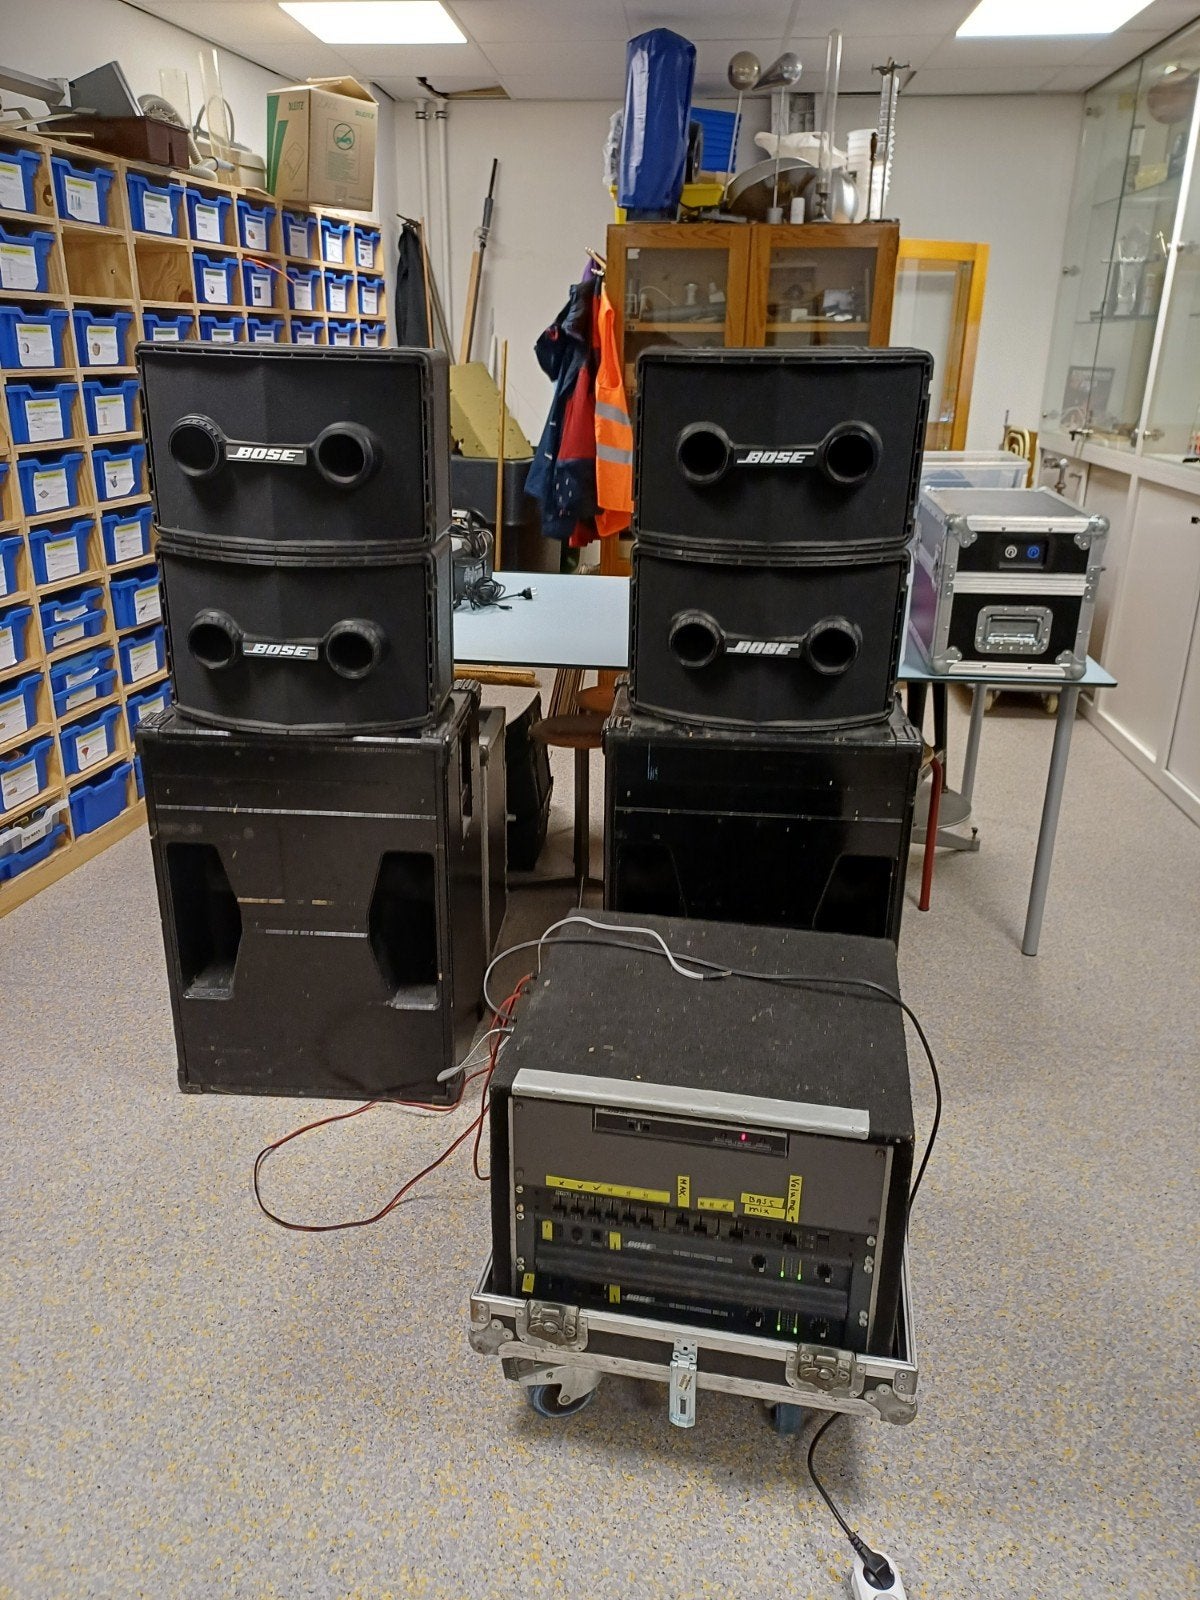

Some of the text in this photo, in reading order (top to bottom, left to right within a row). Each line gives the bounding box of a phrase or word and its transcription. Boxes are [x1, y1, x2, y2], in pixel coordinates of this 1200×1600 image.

[228, 446, 303, 462] BOSE
[737, 450, 814, 464] BOSE
[244, 642, 316, 657] BOSE
